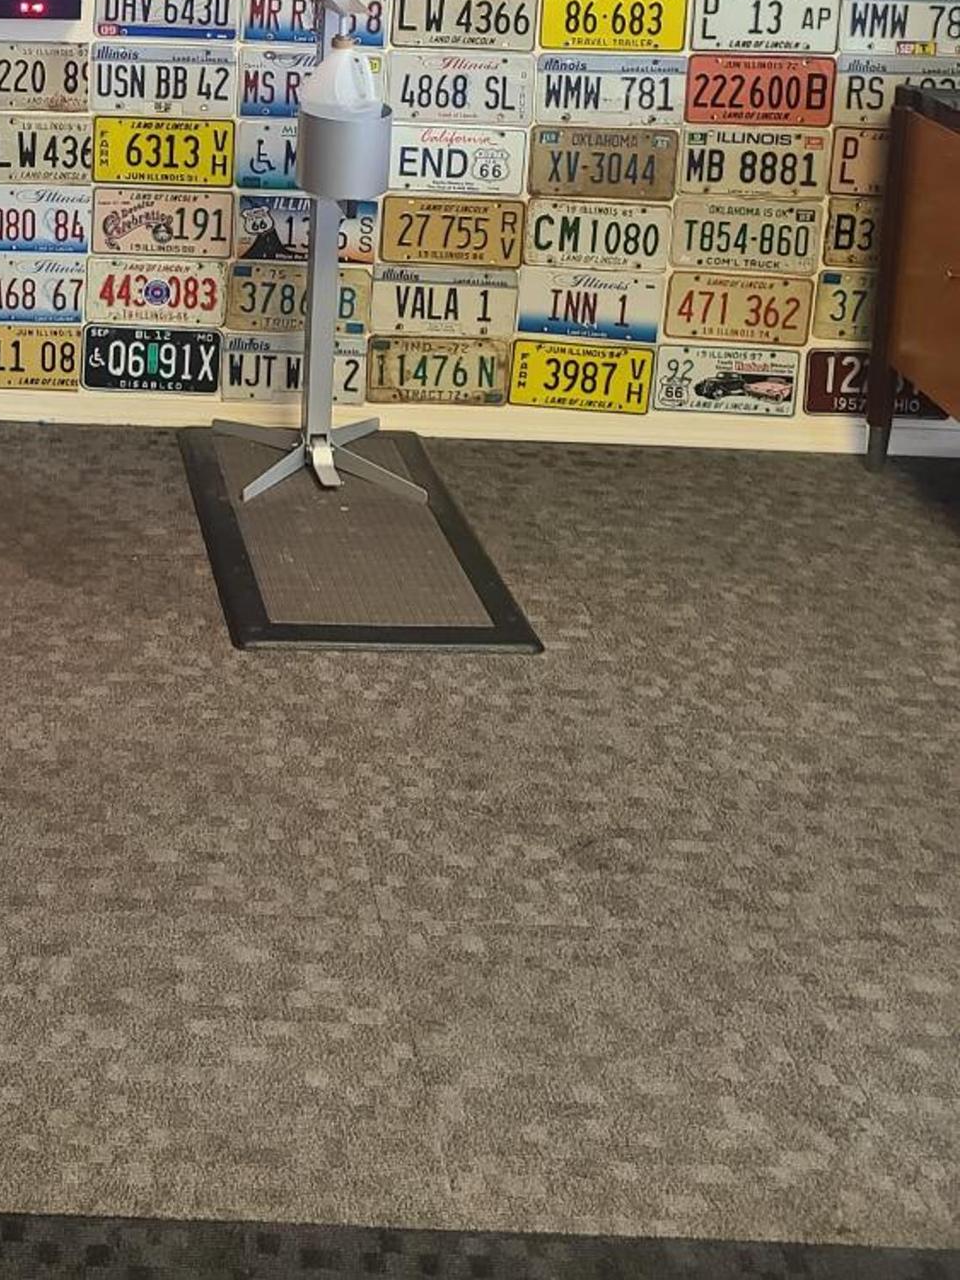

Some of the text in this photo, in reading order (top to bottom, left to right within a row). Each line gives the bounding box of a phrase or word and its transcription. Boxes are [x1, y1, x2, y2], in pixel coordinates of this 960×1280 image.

[456, 0, 529, 35] 4366
[748, 0, 831, 34] 13 AP
[97, 65, 229, 100] USN BB 42
[401, 75, 515, 110] 4868 SL
[126, 133, 199, 168] 6313
[421, 130, 496, 145] California
[572, 135, 638, 148] OKLAHOMA
[716, 133, 791, 144] ILLINOIS
[399, 147, 468, 178] END
[687, 149, 817, 186] MB 8881
[174, 208, 226, 241] 191
[53, 279, 83, 310] 67
[678, 290, 800, 330] 471 362
[41, 340, 75, 372] 08
[119, 380, 182, 389] DISABLED
[544, 358, 617, 395] 3987
